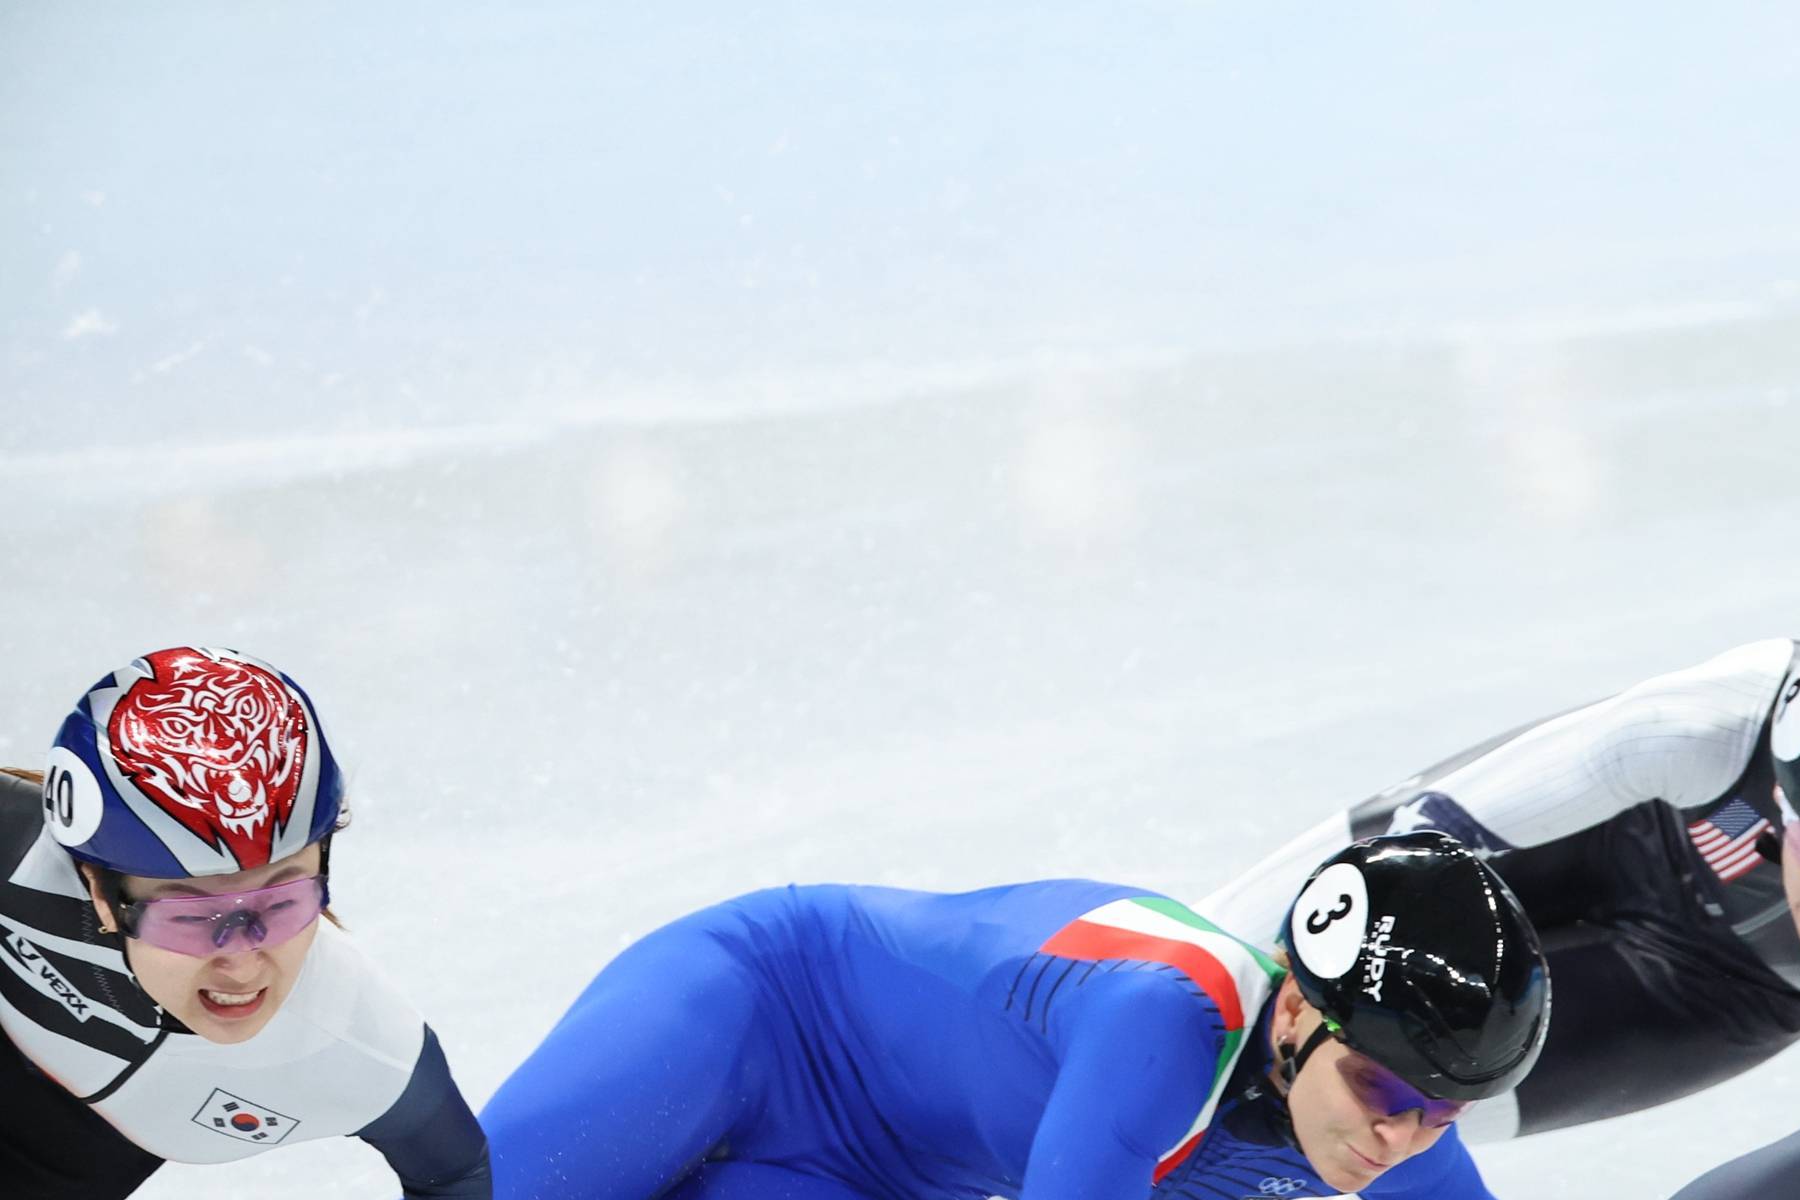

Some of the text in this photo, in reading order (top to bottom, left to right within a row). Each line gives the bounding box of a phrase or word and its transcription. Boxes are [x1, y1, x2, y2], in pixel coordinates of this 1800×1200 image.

[45, 765, 74, 828] 40
[1306, 893, 1353, 935] 3
[1362, 915, 1396, 1002] RUDY
